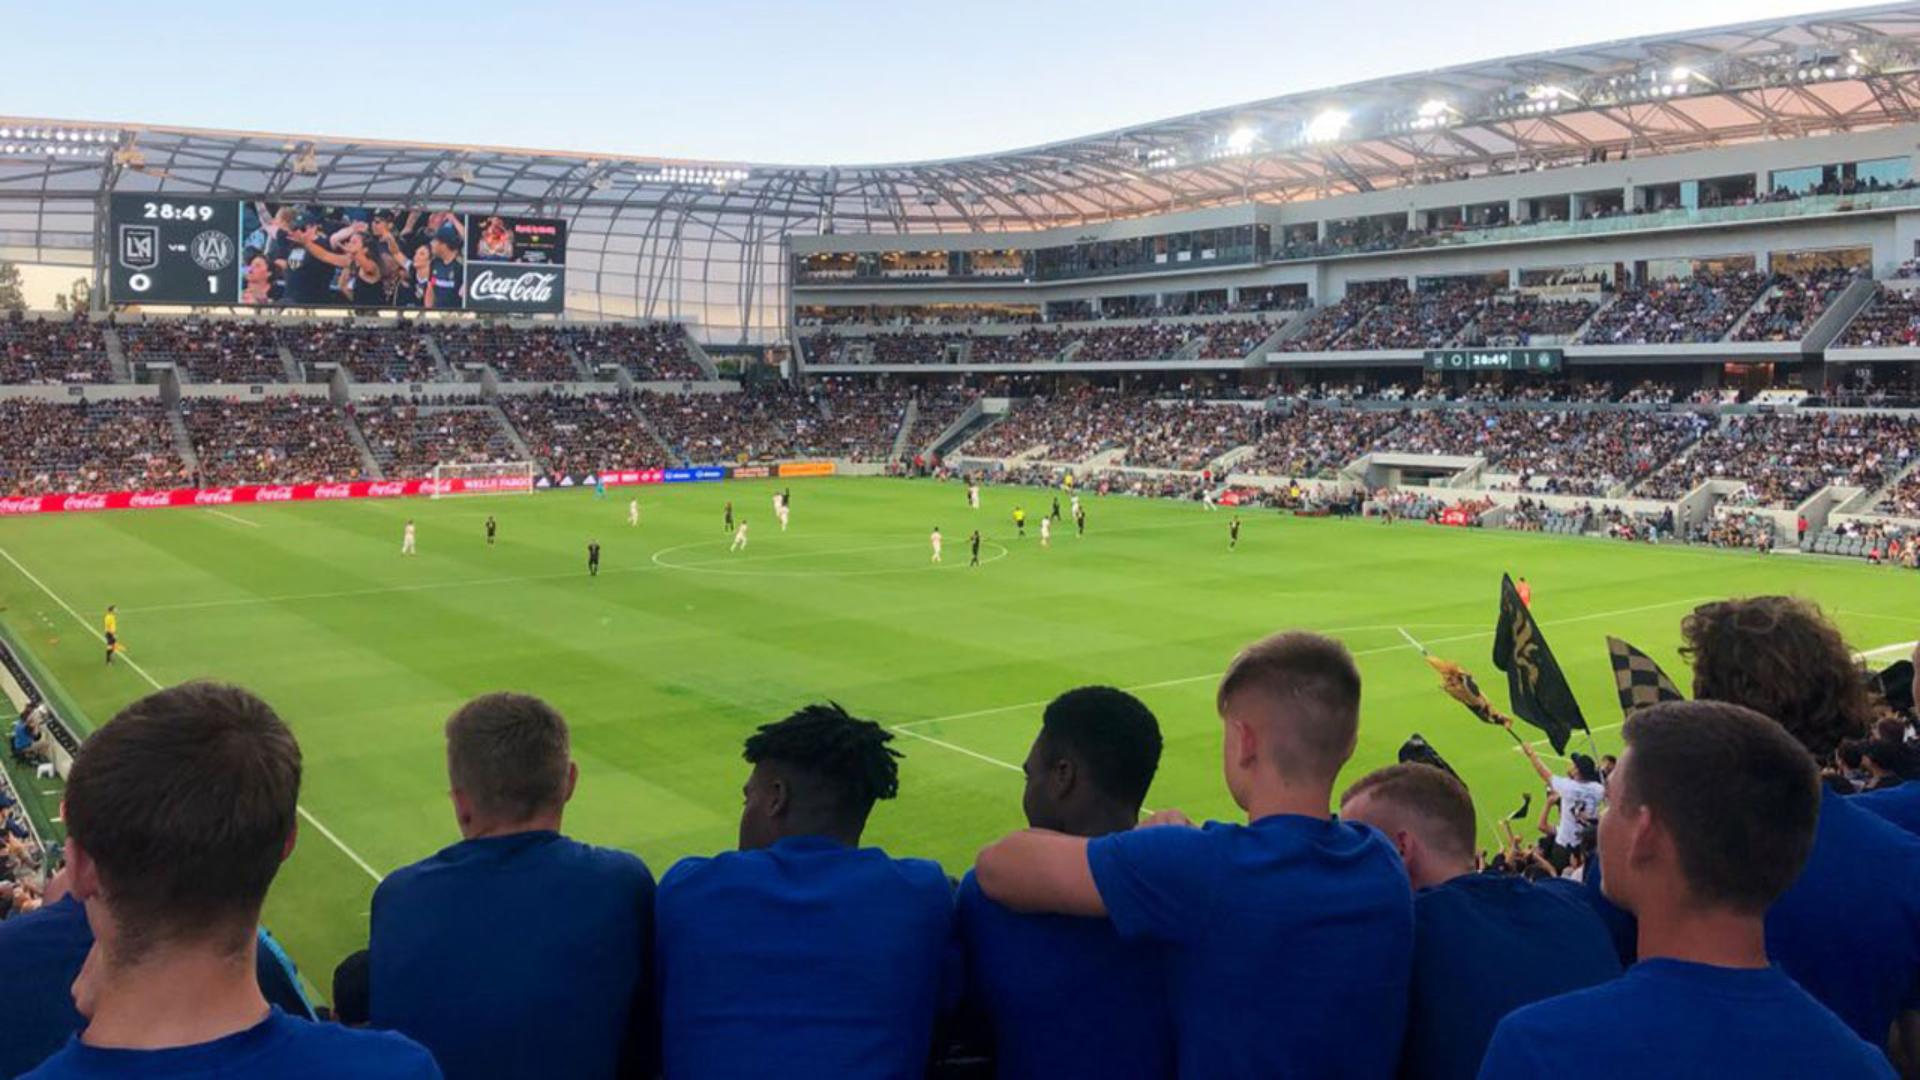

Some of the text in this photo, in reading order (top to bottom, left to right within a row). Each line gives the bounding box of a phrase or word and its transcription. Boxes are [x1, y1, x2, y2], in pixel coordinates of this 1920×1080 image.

[144, 203, 213, 221] 28:49
[129, 274, 151, 292] 0
[208, 276, 218, 294] 1
[470, 270, 557, 302] Coca-Cola
[1473, 354, 1508, 366] 28:49
